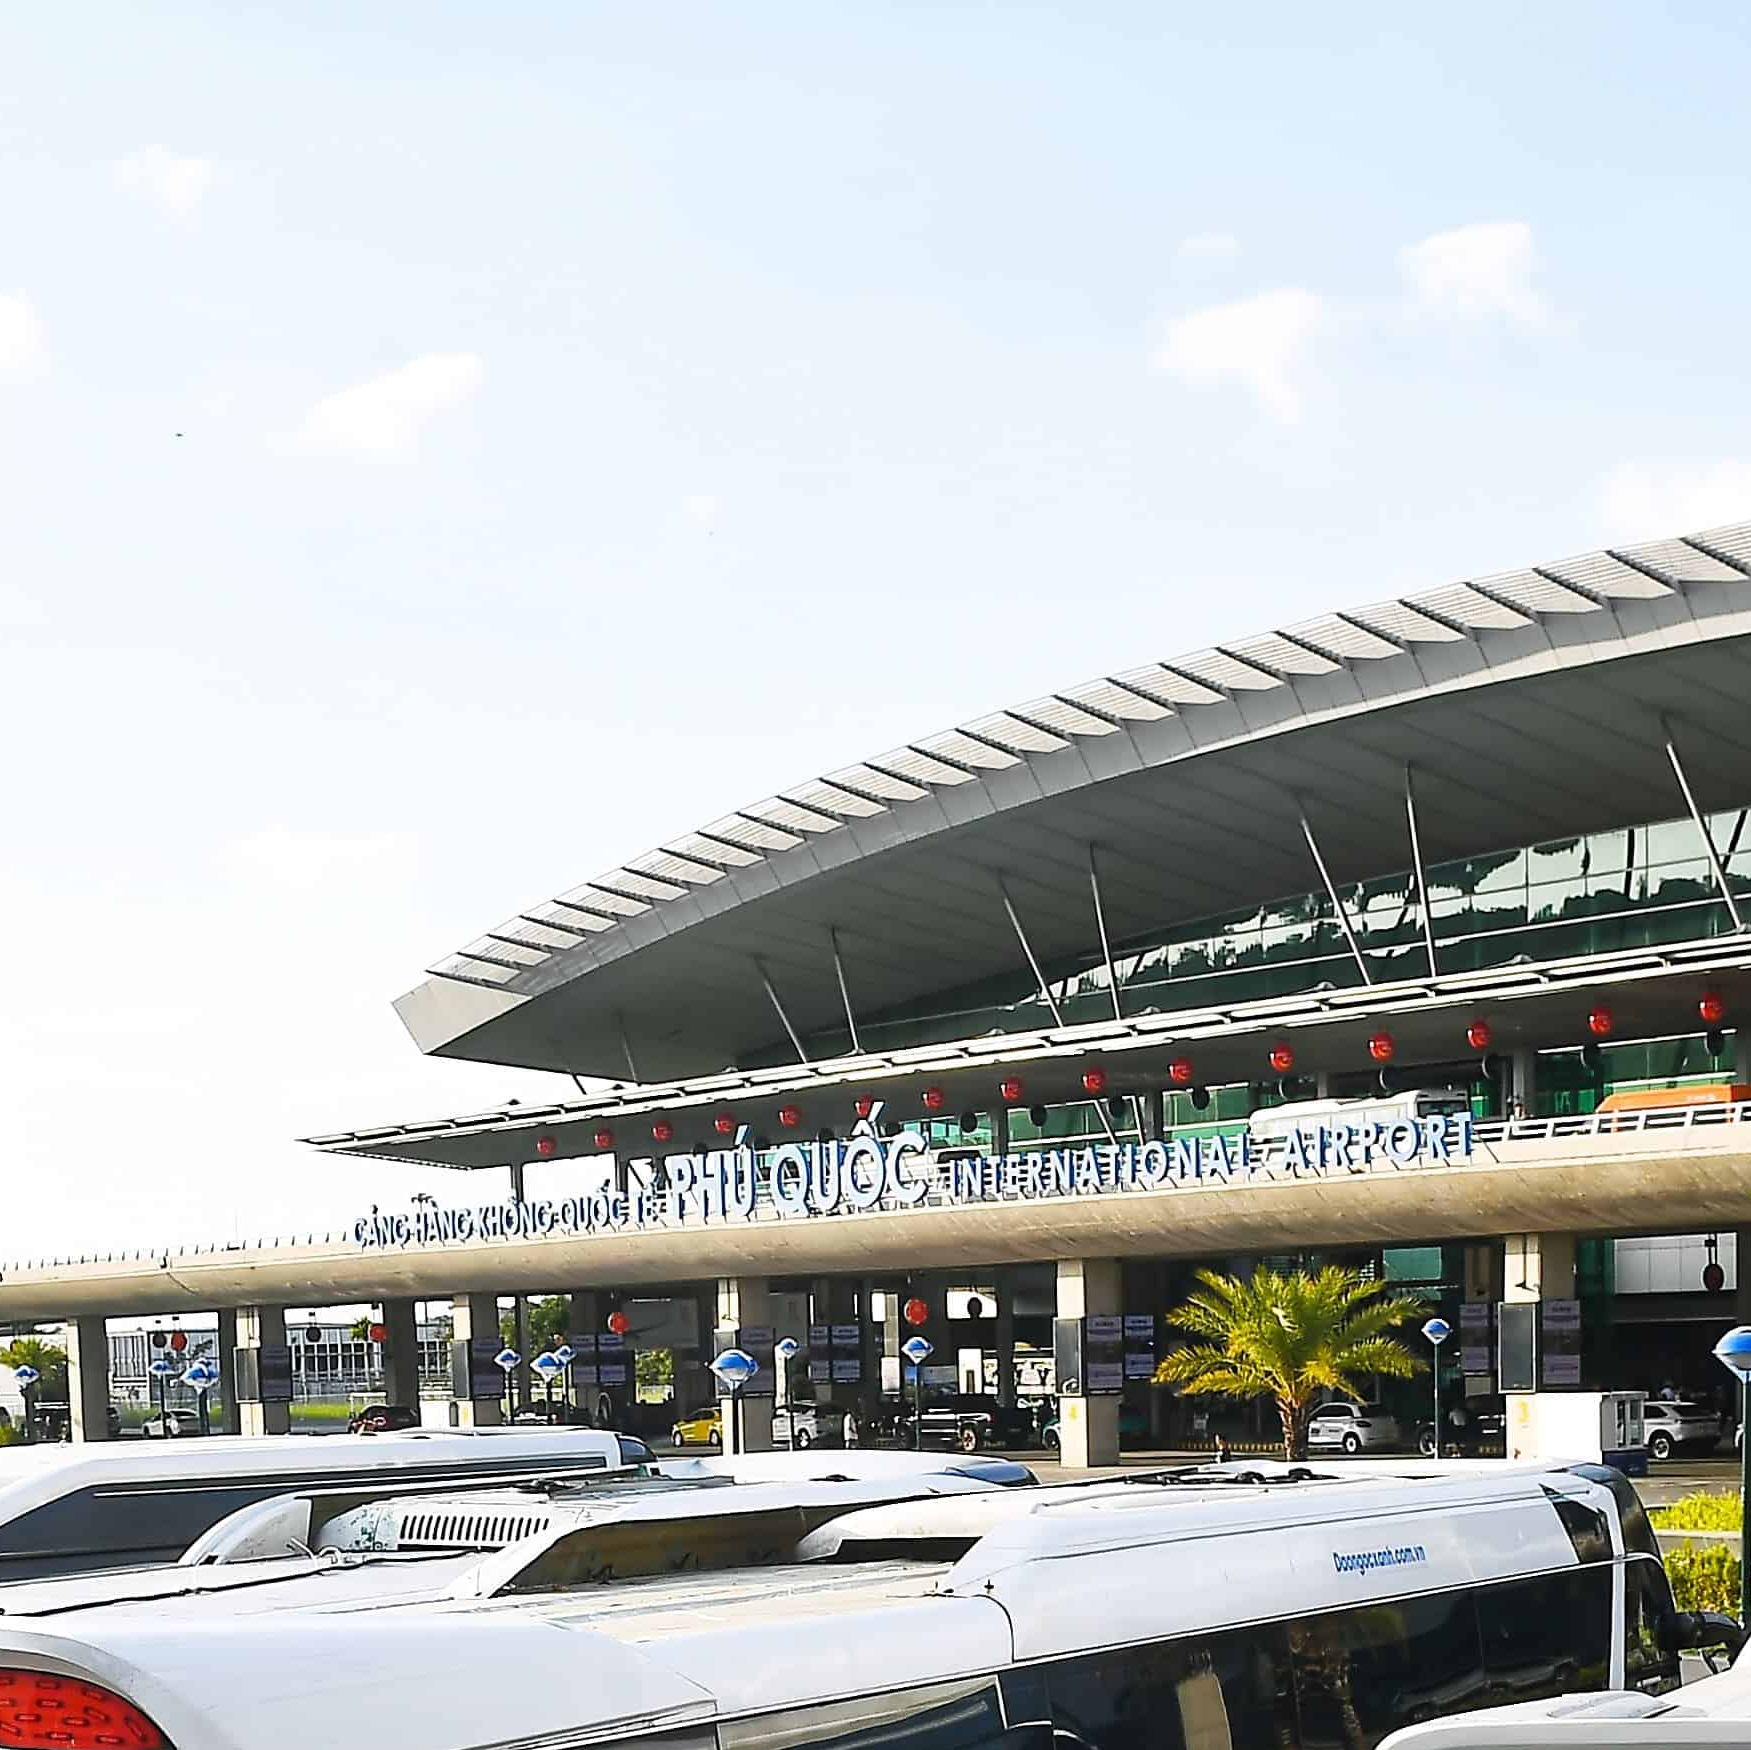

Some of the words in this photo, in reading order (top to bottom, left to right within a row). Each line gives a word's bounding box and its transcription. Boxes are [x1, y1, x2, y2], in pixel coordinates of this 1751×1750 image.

[354, 1205, 409, 1247] CẢNG
[413, 1198, 472, 1242] HÀNG
[479, 1190, 554, 1236] KHÔNG
[561, 1179, 629, 1230] QUỐC
[665, 1124, 755, 1220] PHÚ
[770, 1101, 930, 1217] QUỐC
[949, 1133, 1251, 1199] INTERNATIONAL
[1284, 1112, 1473, 1171] AIRPORT
